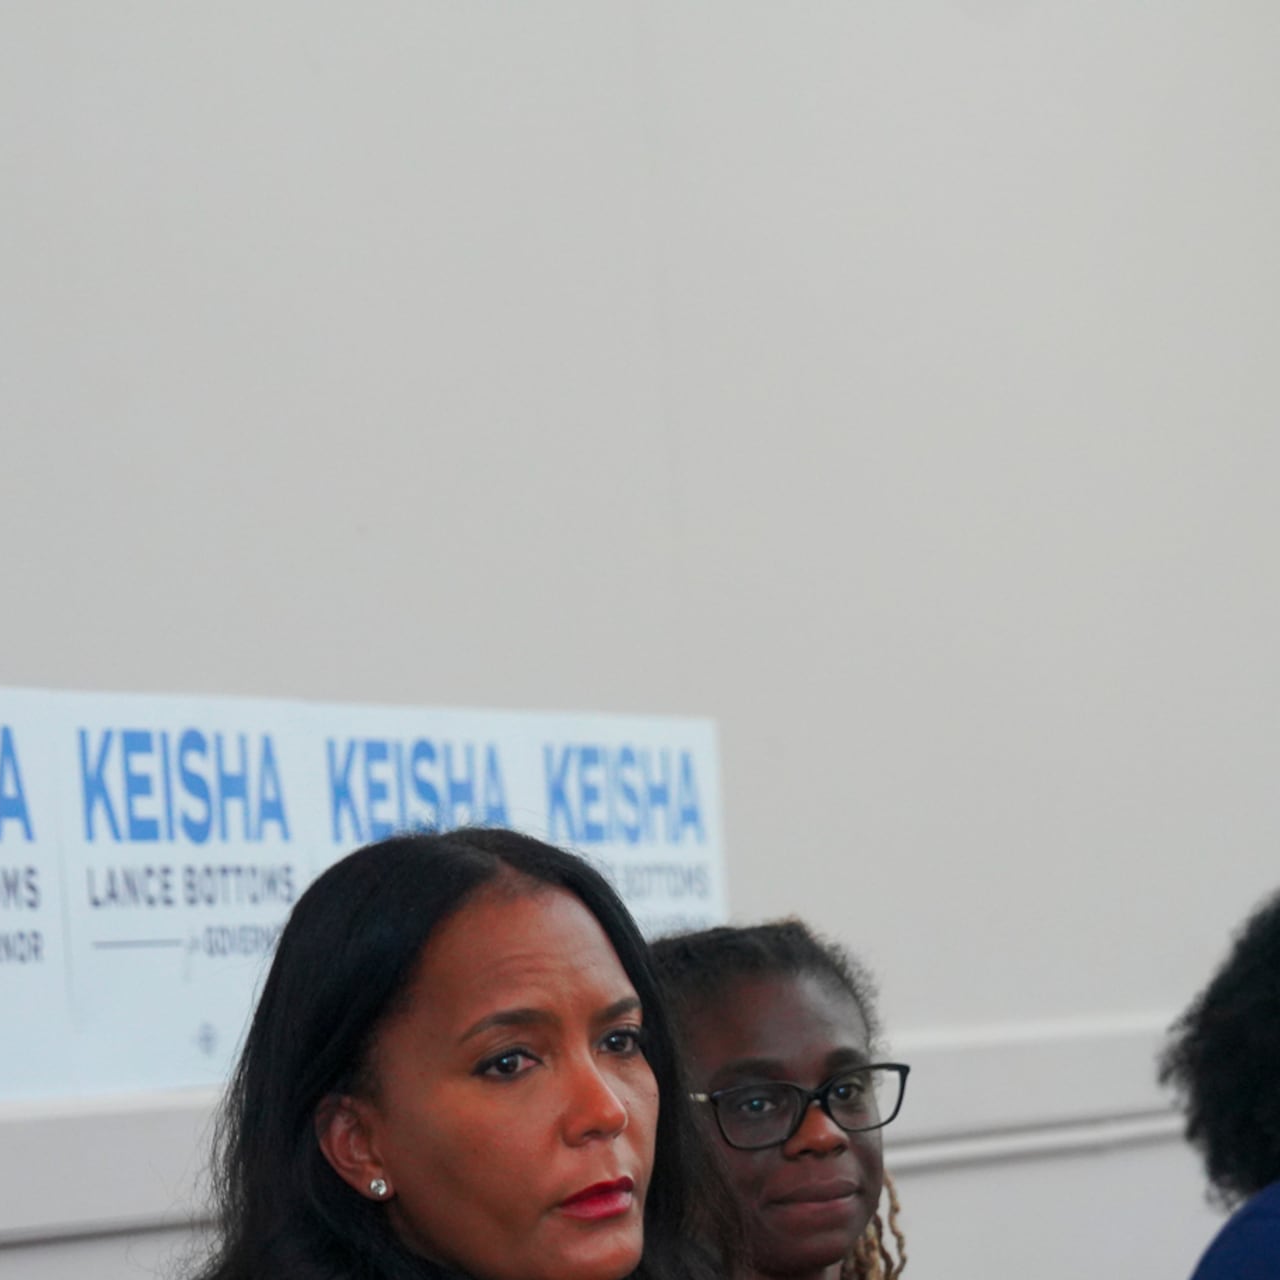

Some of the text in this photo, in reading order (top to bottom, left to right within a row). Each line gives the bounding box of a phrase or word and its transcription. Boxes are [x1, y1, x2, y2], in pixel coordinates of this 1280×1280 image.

[77, 727, 292, 845] KEISHA
[326, 735, 511, 846] KEISHA
[542, 742, 707, 846] KEISHA
[86, 864, 295, 907] LANCE BOTTOMS
